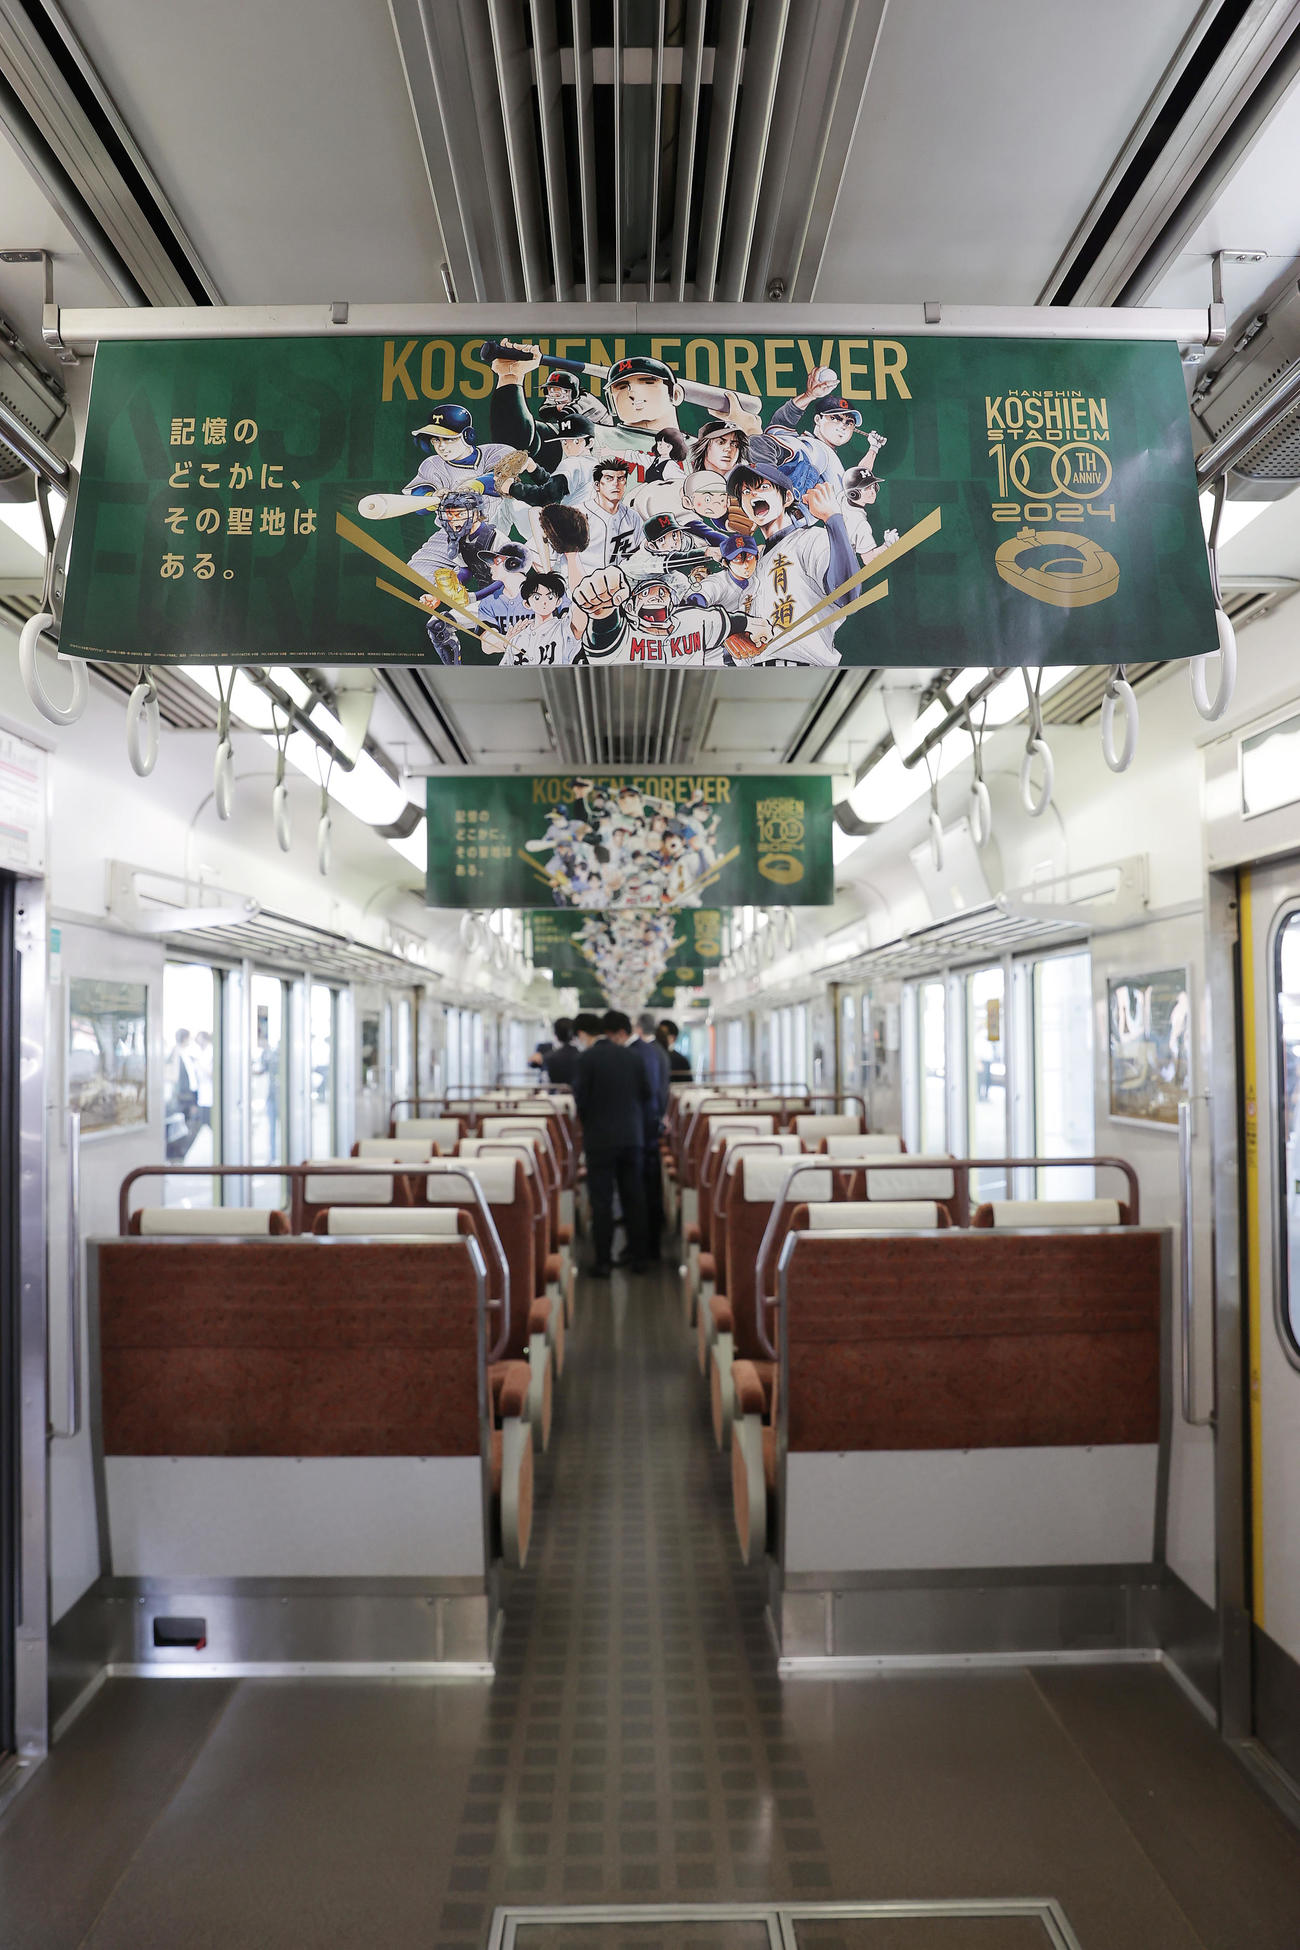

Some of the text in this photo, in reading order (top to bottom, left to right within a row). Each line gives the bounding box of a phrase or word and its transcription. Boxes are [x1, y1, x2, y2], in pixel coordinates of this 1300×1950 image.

[432, 414, 444, 424] T
[985, 396, 1109, 429] KOSHIEN
[170, 417, 259, 445] 記憶の
[561, 421, 572, 431] M
[987, 429, 1110, 441] STADIUM
[988, 441, 1113, 500] 100
[1076, 452, 1097, 471] TH
[168, 461, 301, 490] どこかに、
[859, 469, 872, 479] M
[1072, 472, 1103, 484] ANNIV.
[164, 506, 318, 536] その聖地は
[657, 516, 672, 528] M
[991, 502, 1116, 523] 2024
[160, 552, 235, 580] ある。
[768, 553, 797, 630] 青道
